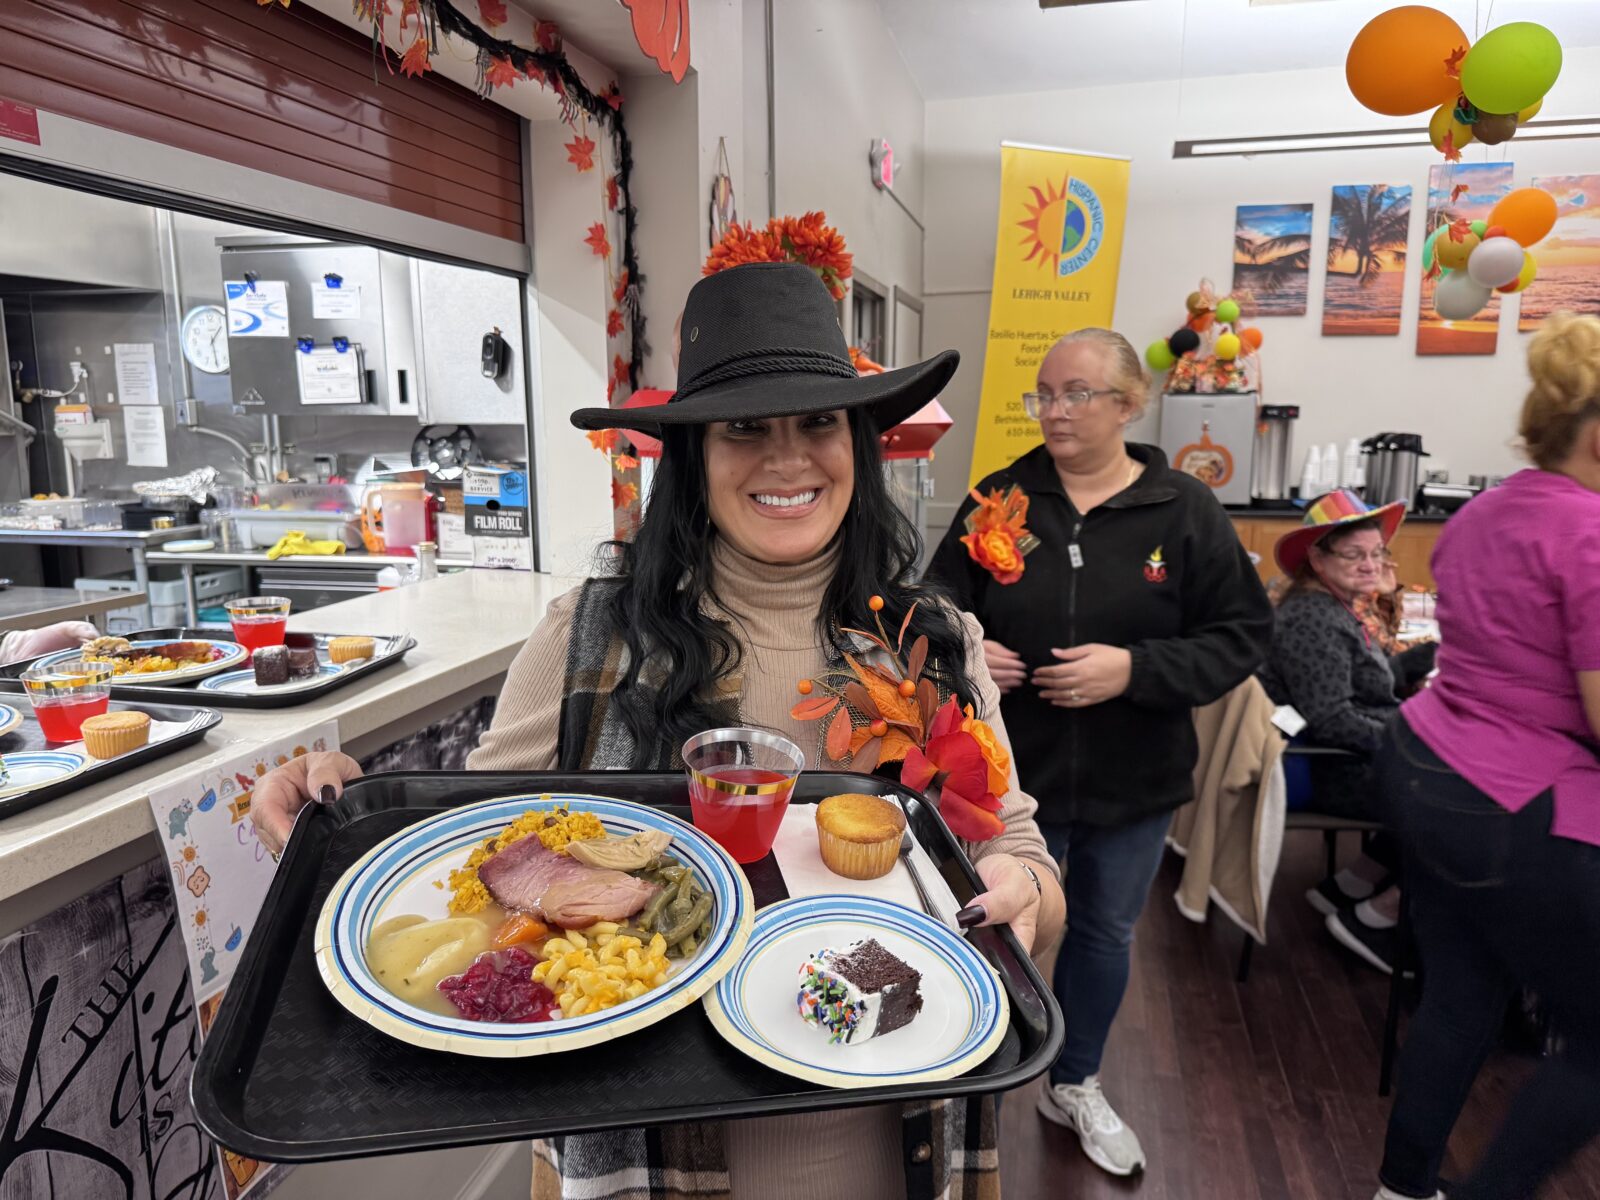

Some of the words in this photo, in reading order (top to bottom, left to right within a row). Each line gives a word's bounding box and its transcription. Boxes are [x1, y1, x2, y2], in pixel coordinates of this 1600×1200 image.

[1012, 288, 1052, 300] LEHIGH
[1054, 290, 1091, 302] VALLEY
[474, 515, 497, 530] FILM
[498, 516, 522, 531] ROLL
[61, 948, 143, 1047] THE
